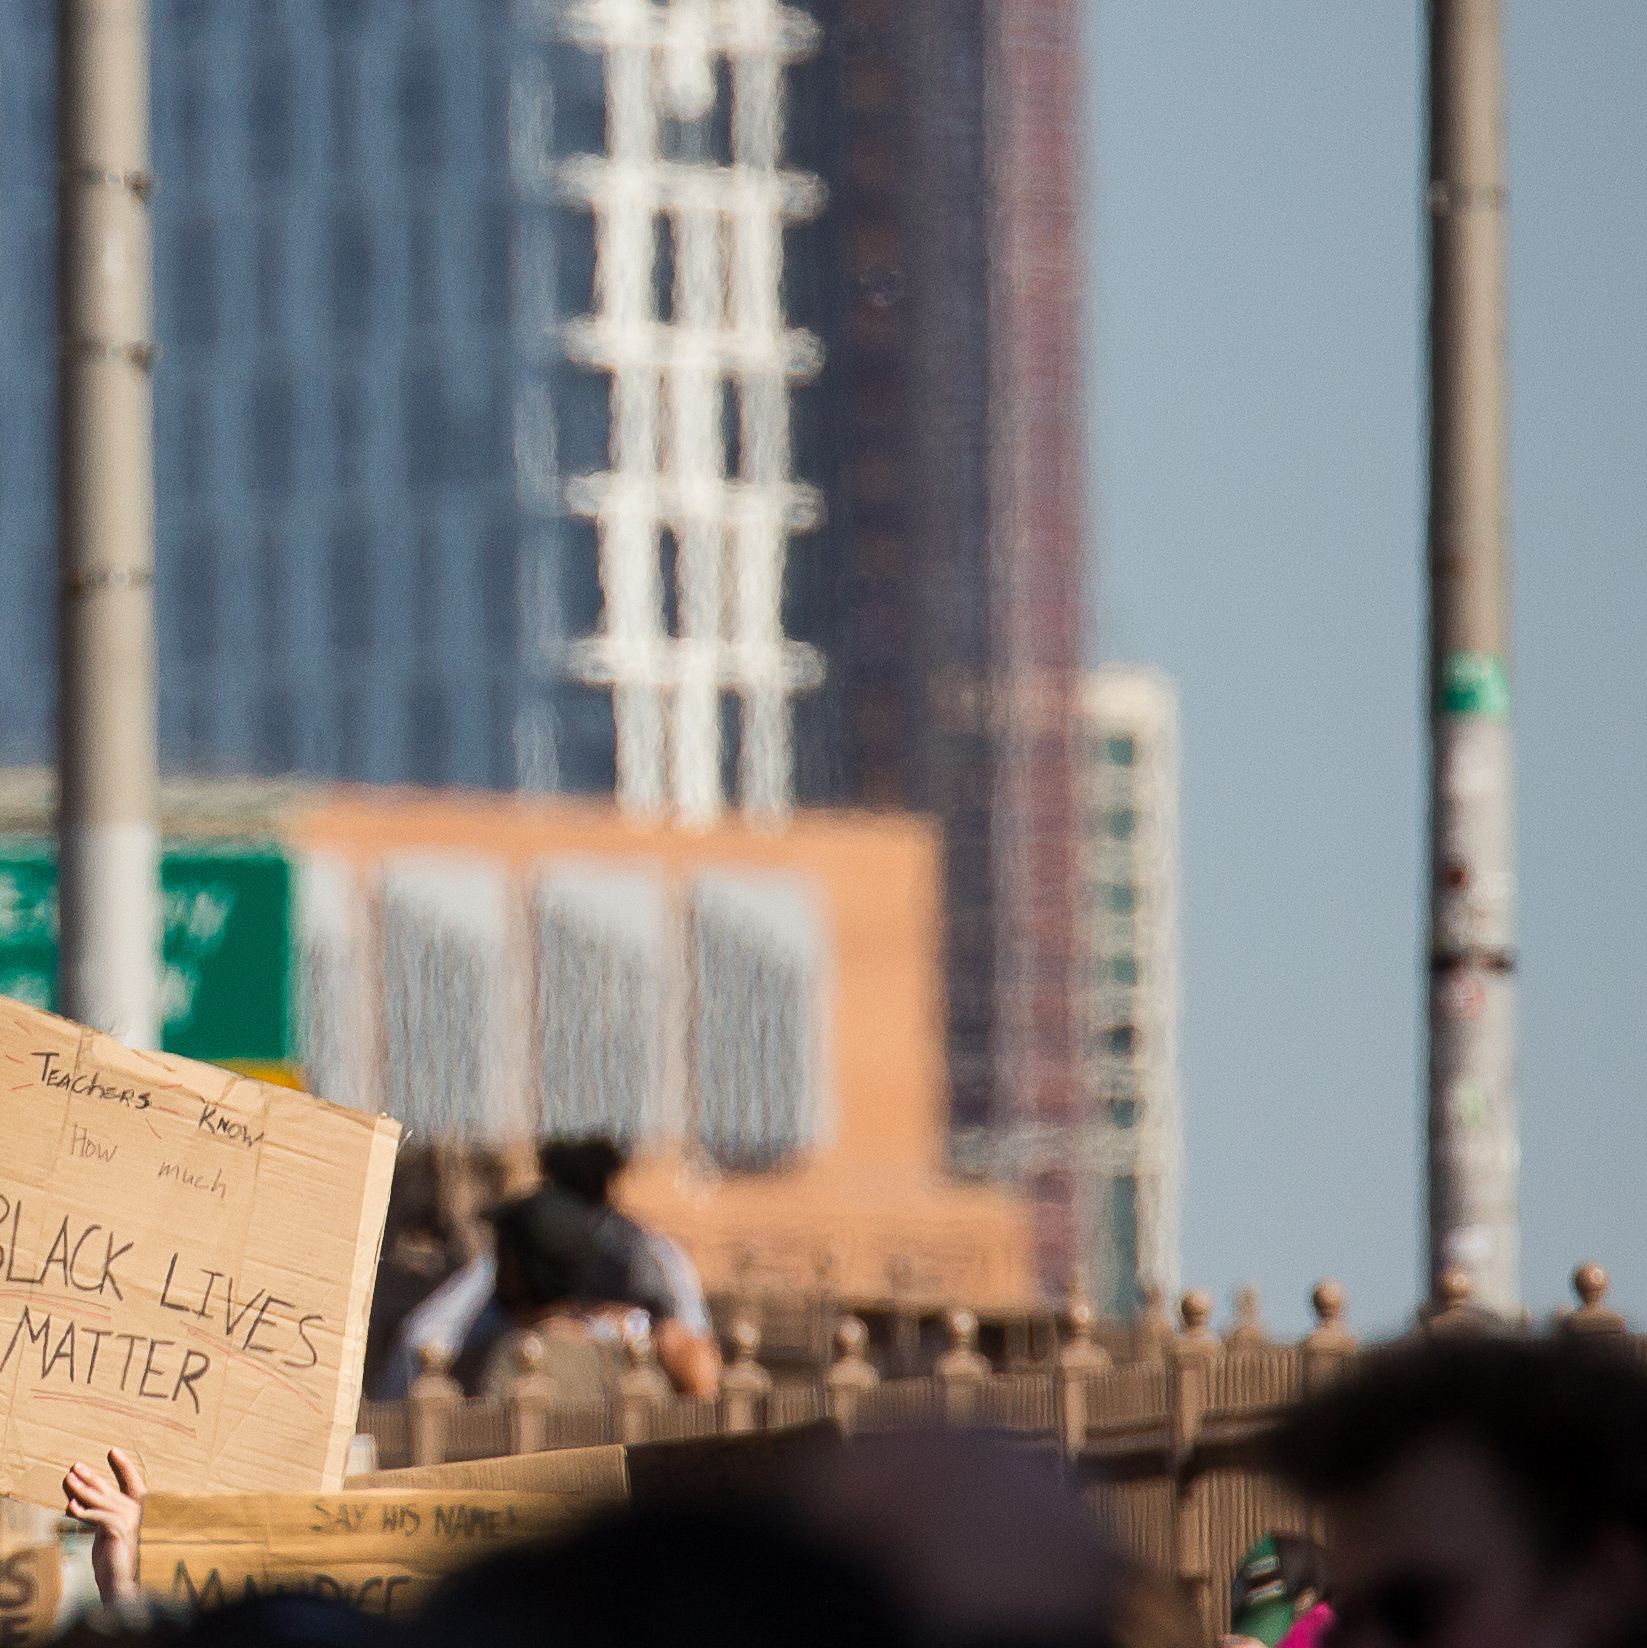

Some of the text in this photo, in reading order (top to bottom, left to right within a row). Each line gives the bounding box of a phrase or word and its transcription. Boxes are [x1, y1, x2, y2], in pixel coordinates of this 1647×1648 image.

[0, 1306, 211, 1416] MATTER
[160, 1252, 325, 1369] LIVES
[310, 1502, 368, 1533] SAY
